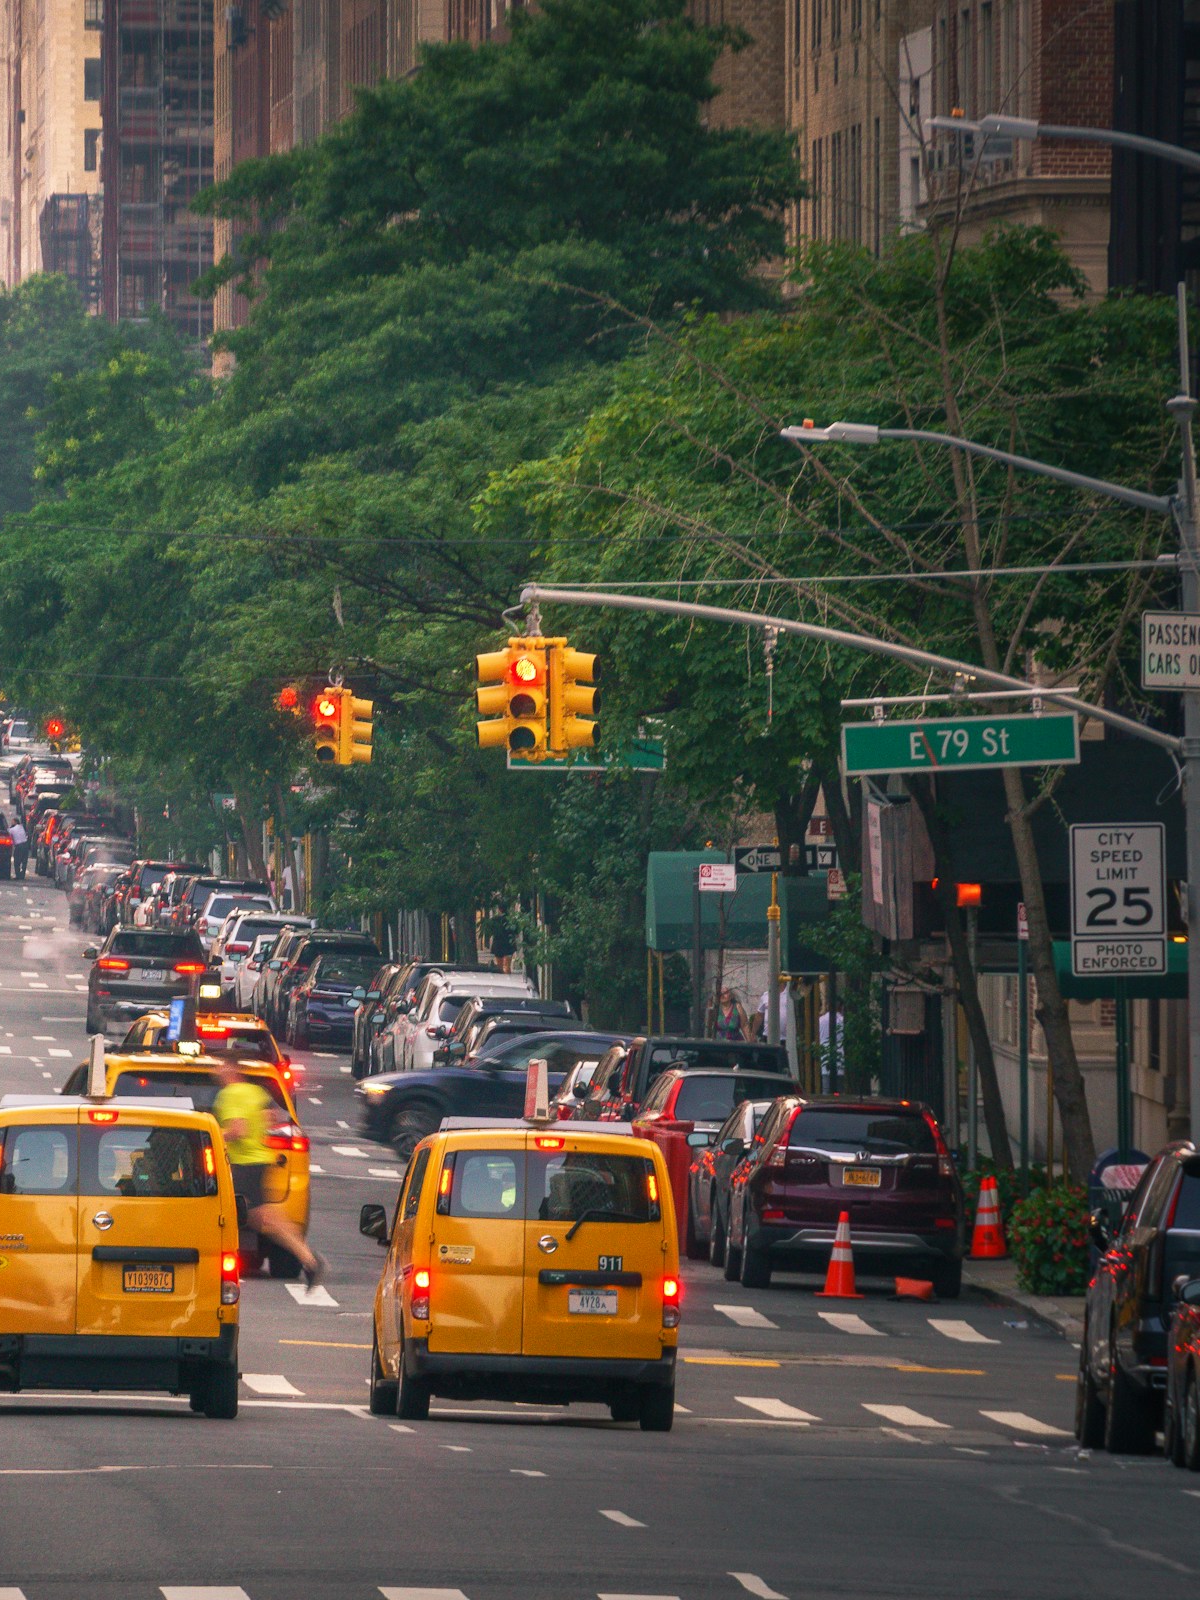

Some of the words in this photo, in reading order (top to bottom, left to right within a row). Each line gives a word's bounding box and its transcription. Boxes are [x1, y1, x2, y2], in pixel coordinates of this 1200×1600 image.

[1148, 623, 1200, 646] PASSEN
[1148, 653, 1181, 674] CARS
[1189, 654, 1200, 675] O
[910, 731, 926, 760] E
[937, 729, 969, 758] 79
[982, 727, 1010, 756] St
[1098, 832, 1135, 846] CITY
[747, 855, 771, 866] ONE
[1090, 850, 1143, 863] SPEED
[1096, 867, 1138, 881] LIMIT
[1086, 887, 1153, 927] 25
[1096, 944, 1142, 956] PHOTO
[1082, 956, 1157, 968] ENFORCED
[599, 1256, 622, 1271] 911
